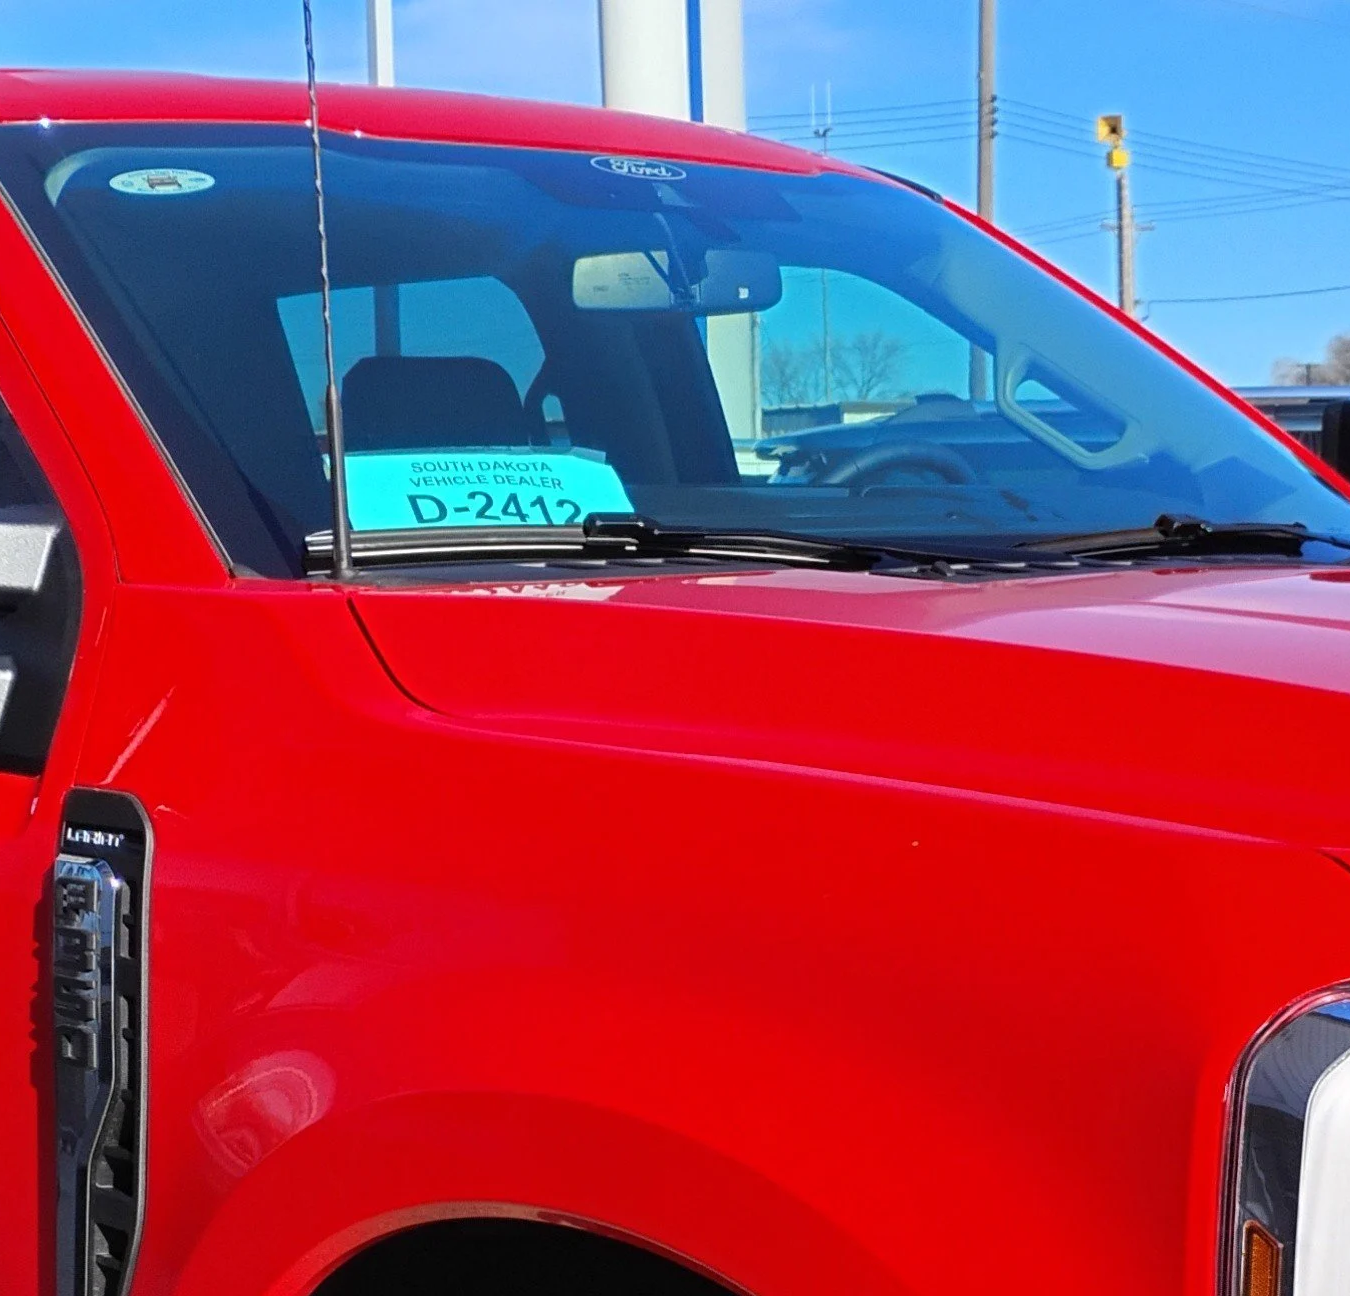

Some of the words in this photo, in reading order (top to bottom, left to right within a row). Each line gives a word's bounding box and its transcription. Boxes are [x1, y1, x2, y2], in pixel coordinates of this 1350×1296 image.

[609, 157, 672, 177] Ford
[410, 461, 474, 474] SOUTH
[477, 461, 553, 473] DAKOTA
[409, 474, 489, 488] VEHICLE
[494, 475, 565, 491] DEALER
[406, 490, 583, 527] D-2412
